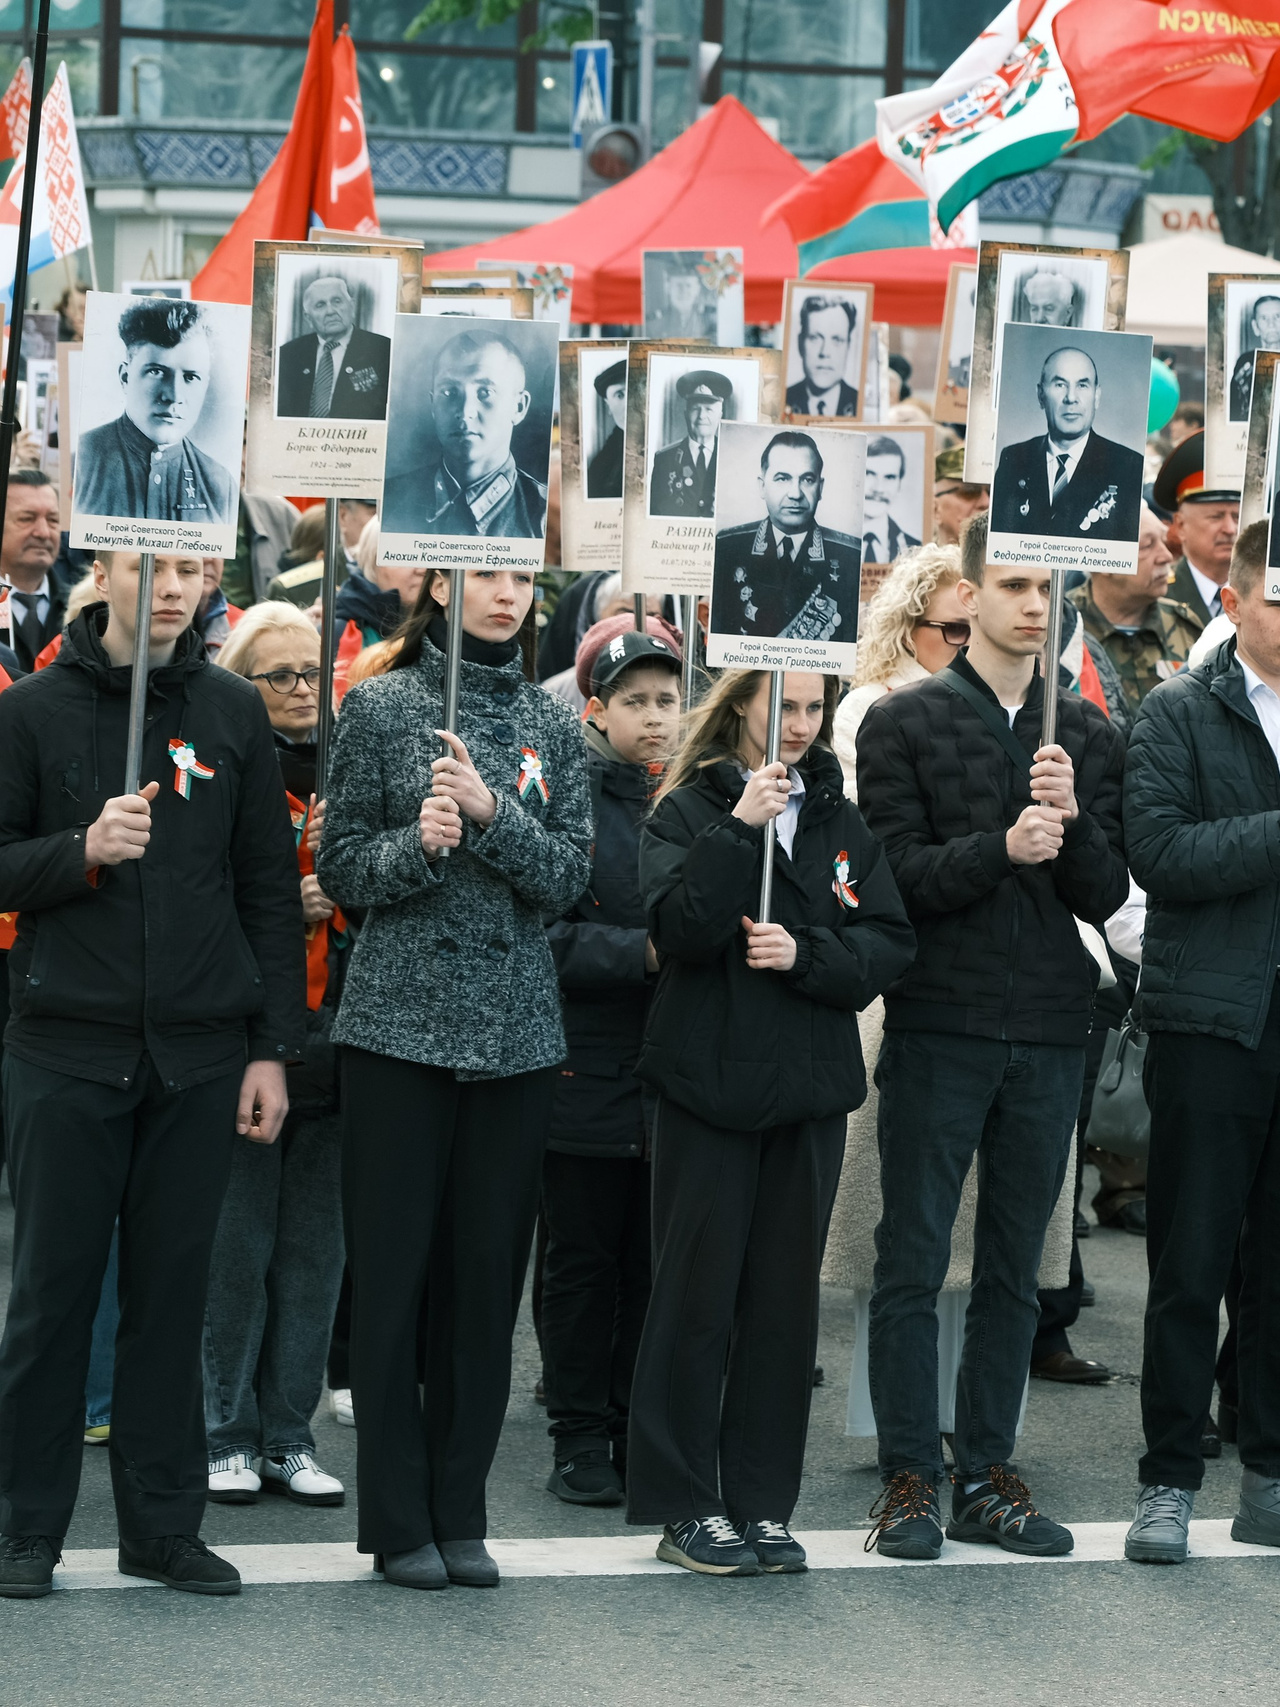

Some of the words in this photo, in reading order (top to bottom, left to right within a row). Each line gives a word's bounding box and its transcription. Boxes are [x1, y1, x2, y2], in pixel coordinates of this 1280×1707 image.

[298, 427, 368, 440] БЛОЦКИЙ
[286, 442, 318, 454] Борис
[321, 443, 378, 455] Фёдорович
[310, 461, 327, 469] 1924
[105, 523, 129, 533] Герой
[131, 525, 176, 536] Советского
[177, 528, 203, 538] Союза
[84, 533, 134, 547] Мормулёв
[136, 537, 174, 549] Михаил
[176, 539, 222, 552] Глебович
[414, 540, 438, 550] Герой
[440, 541, 484, 551] Советского
[486, 543, 511, 552] Союза
[651, 540, 700, 553] Владимир
[1020, 541, 1041, 551] Герой
[1043, 542, 1083, 553] Советского
[1084, 546, 1108, 554] Союза
[383, 551, 419, 562] Анохин
[421, 552, 483, 564] Константин
[486, 554, 540, 566] Ефремович
[993, 550, 1042, 563] Федоренко
[1044, 553, 1078, 565] Степан
[1080, 556, 1132, 568] Алексеевич
[739, 642, 761, 652] Герой
[763, 644, 803, 654] Советского
[804, 647, 827, 656] Союза
[723, 652, 760, 665] Крейзер
[761, 655, 783, 665] Яков
[785, 656, 842, 669] Григорьевич
